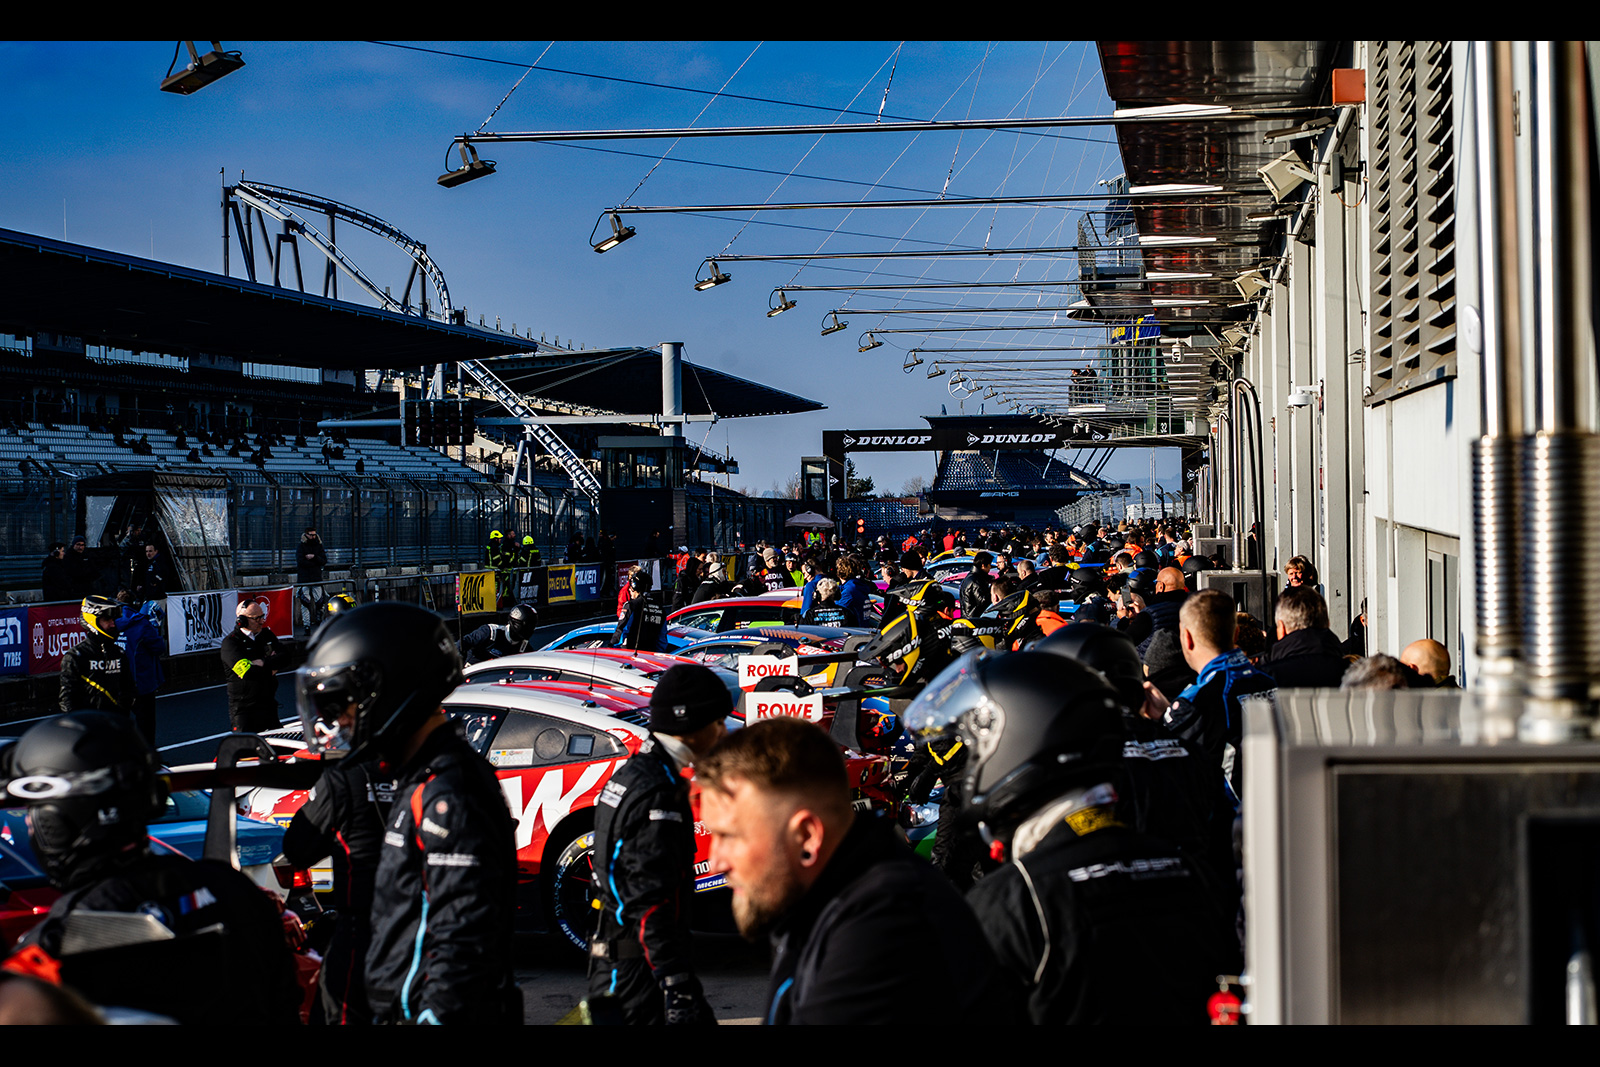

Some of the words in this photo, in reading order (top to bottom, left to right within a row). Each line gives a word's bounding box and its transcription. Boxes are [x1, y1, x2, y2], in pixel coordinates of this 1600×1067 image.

[857, 435, 932, 446] DUNLOP
[980, 433, 1056, 444] DUNLOP
[899, 597, 926, 607] 100%
[972, 626, 1002, 636] 100%
[886, 635, 922, 663] 100%
[3, 651, 22, 667] TYRES
[747, 664, 791, 677] ROWE
[757, 703, 814, 719] ROWE
[696, 878, 728, 890] MICHEL
